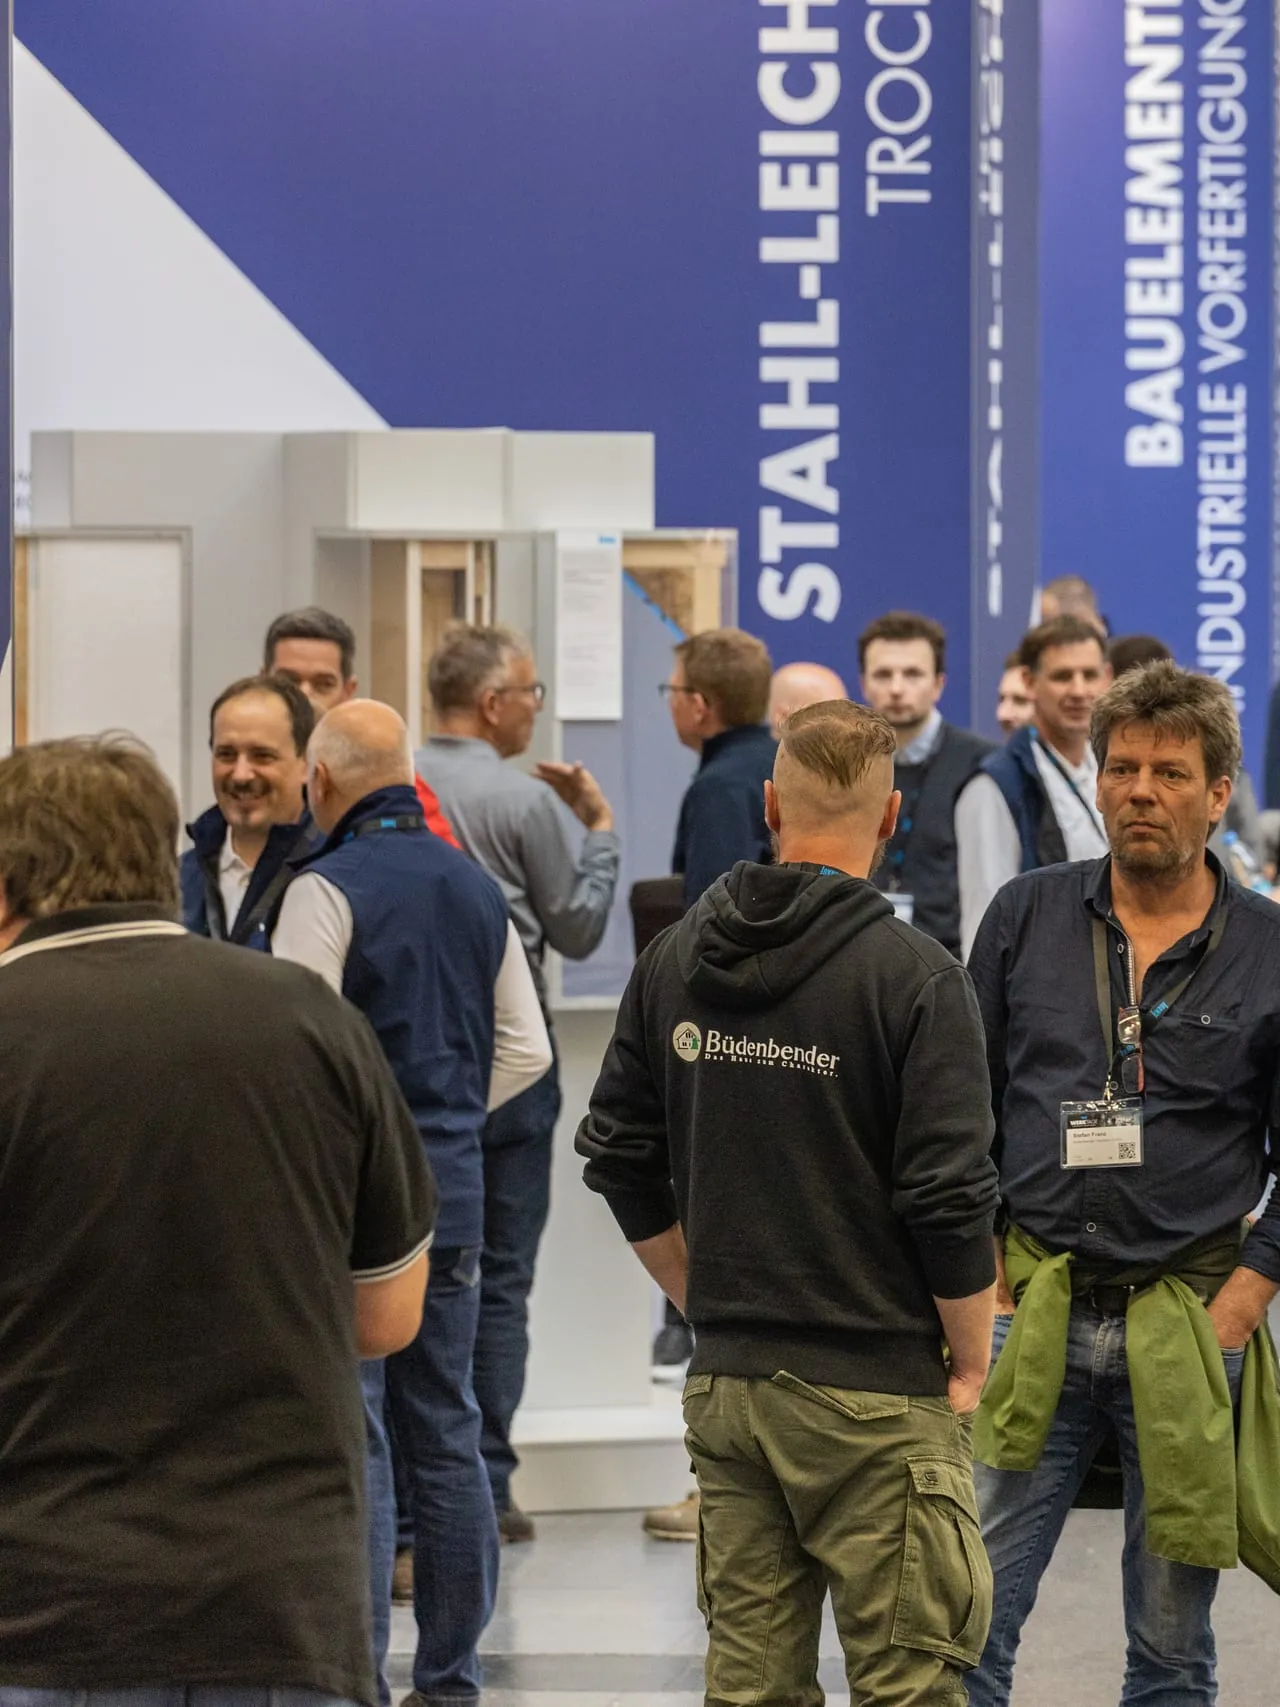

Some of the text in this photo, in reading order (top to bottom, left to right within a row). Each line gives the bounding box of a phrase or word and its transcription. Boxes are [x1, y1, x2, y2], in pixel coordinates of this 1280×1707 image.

[865, 0, 931, 216] TROC
[1124, 0, 1184, 467] BAUELEMENT
[757, 0, 841, 622] STAHL-LEICH
[1197, 383, 1247, 712] NDUSTRIELLE
[704, 1053, 724, 1061] Das
[705, 1029, 841, 1070] Büdenbender
